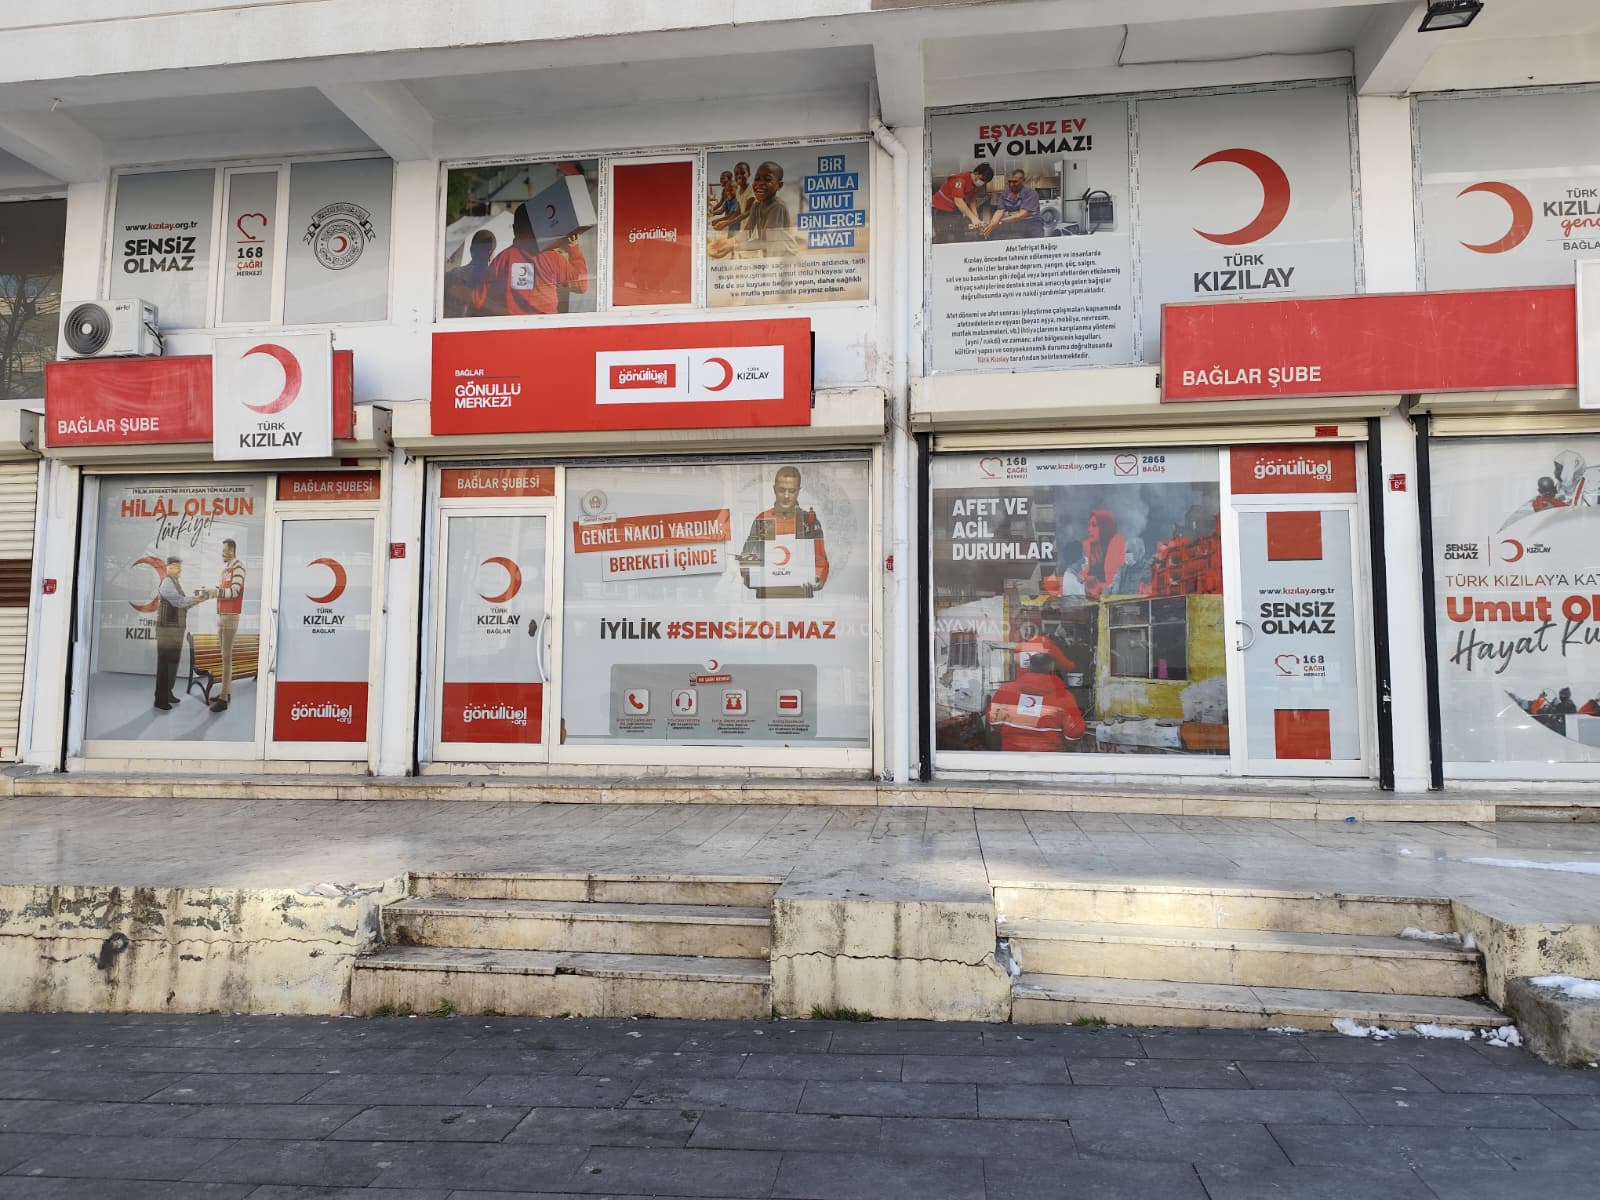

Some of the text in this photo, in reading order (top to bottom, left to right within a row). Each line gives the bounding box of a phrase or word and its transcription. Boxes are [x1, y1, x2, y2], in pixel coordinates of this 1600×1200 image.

[979, 118, 1086, 143] EŞYASIZ EV
[974, 135, 1092, 158] EV OLMAZ!
[807, 176, 855, 191] DAMLA
[1566, 188, 1598, 198] TÜRK
[812, 195, 850, 209] UMUT
[1544, 200, 1600, 216] KIZIL
[811, 232, 851, 247] HAYAT
[238, 247, 263, 258] 168
[1224, 253, 1264, 267] TÜRK
[124, 256, 194, 273] OLMAZ
[237, 260, 263, 270] ÇAĞRI
[1193, 267, 1295, 292] KIZILAY
[737, 372, 769, 380] KIZILAY
[1182, 365, 1321, 388] BAĞLAR ŞUBE
[57, 416, 159, 436] BAĞLAR ŞUBE
[257, 422, 285, 431] TÜRK
[240, 432, 302, 449] KIZILAY
[1006, 457, 1027, 466] 168
[293, 478, 372, 494] BAĞLAR ŞUBESİ
[457, 475, 539, 491] BAĞLAR ŞUBESİ
[184, 497, 254, 516] OLSUN
[952, 498, 1028, 516] AFET VE
[582, 528, 620, 545] GENEL
[624, 521, 664, 541] NAKDİ
[952, 517, 994, 538] ACİL
[953, 542, 1053, 560] DURUMLAR
[1445, 552, 1478, 560] OLMAZ
[610, 547, 717, 572] BEREKETİ İÇİNDE
[1446, 574, 1488, 587] TÜRK
[1447, 596, 1552, 622] Umut
[303, 616, 344, 624] KIZILAY
[477, 615, 520, 624] KIZILAY
[1262, 619, 1335, 634] OLMAZ
[126, 627, 156, 639] KIZIL
[600, 618, 661, 639] İYİLİK
[667, 617, 836, 639] #SENSİZOLMAZ
[1450, 620, 1557, 674] Hayat
[1304, 655, 1324, 663] 168
